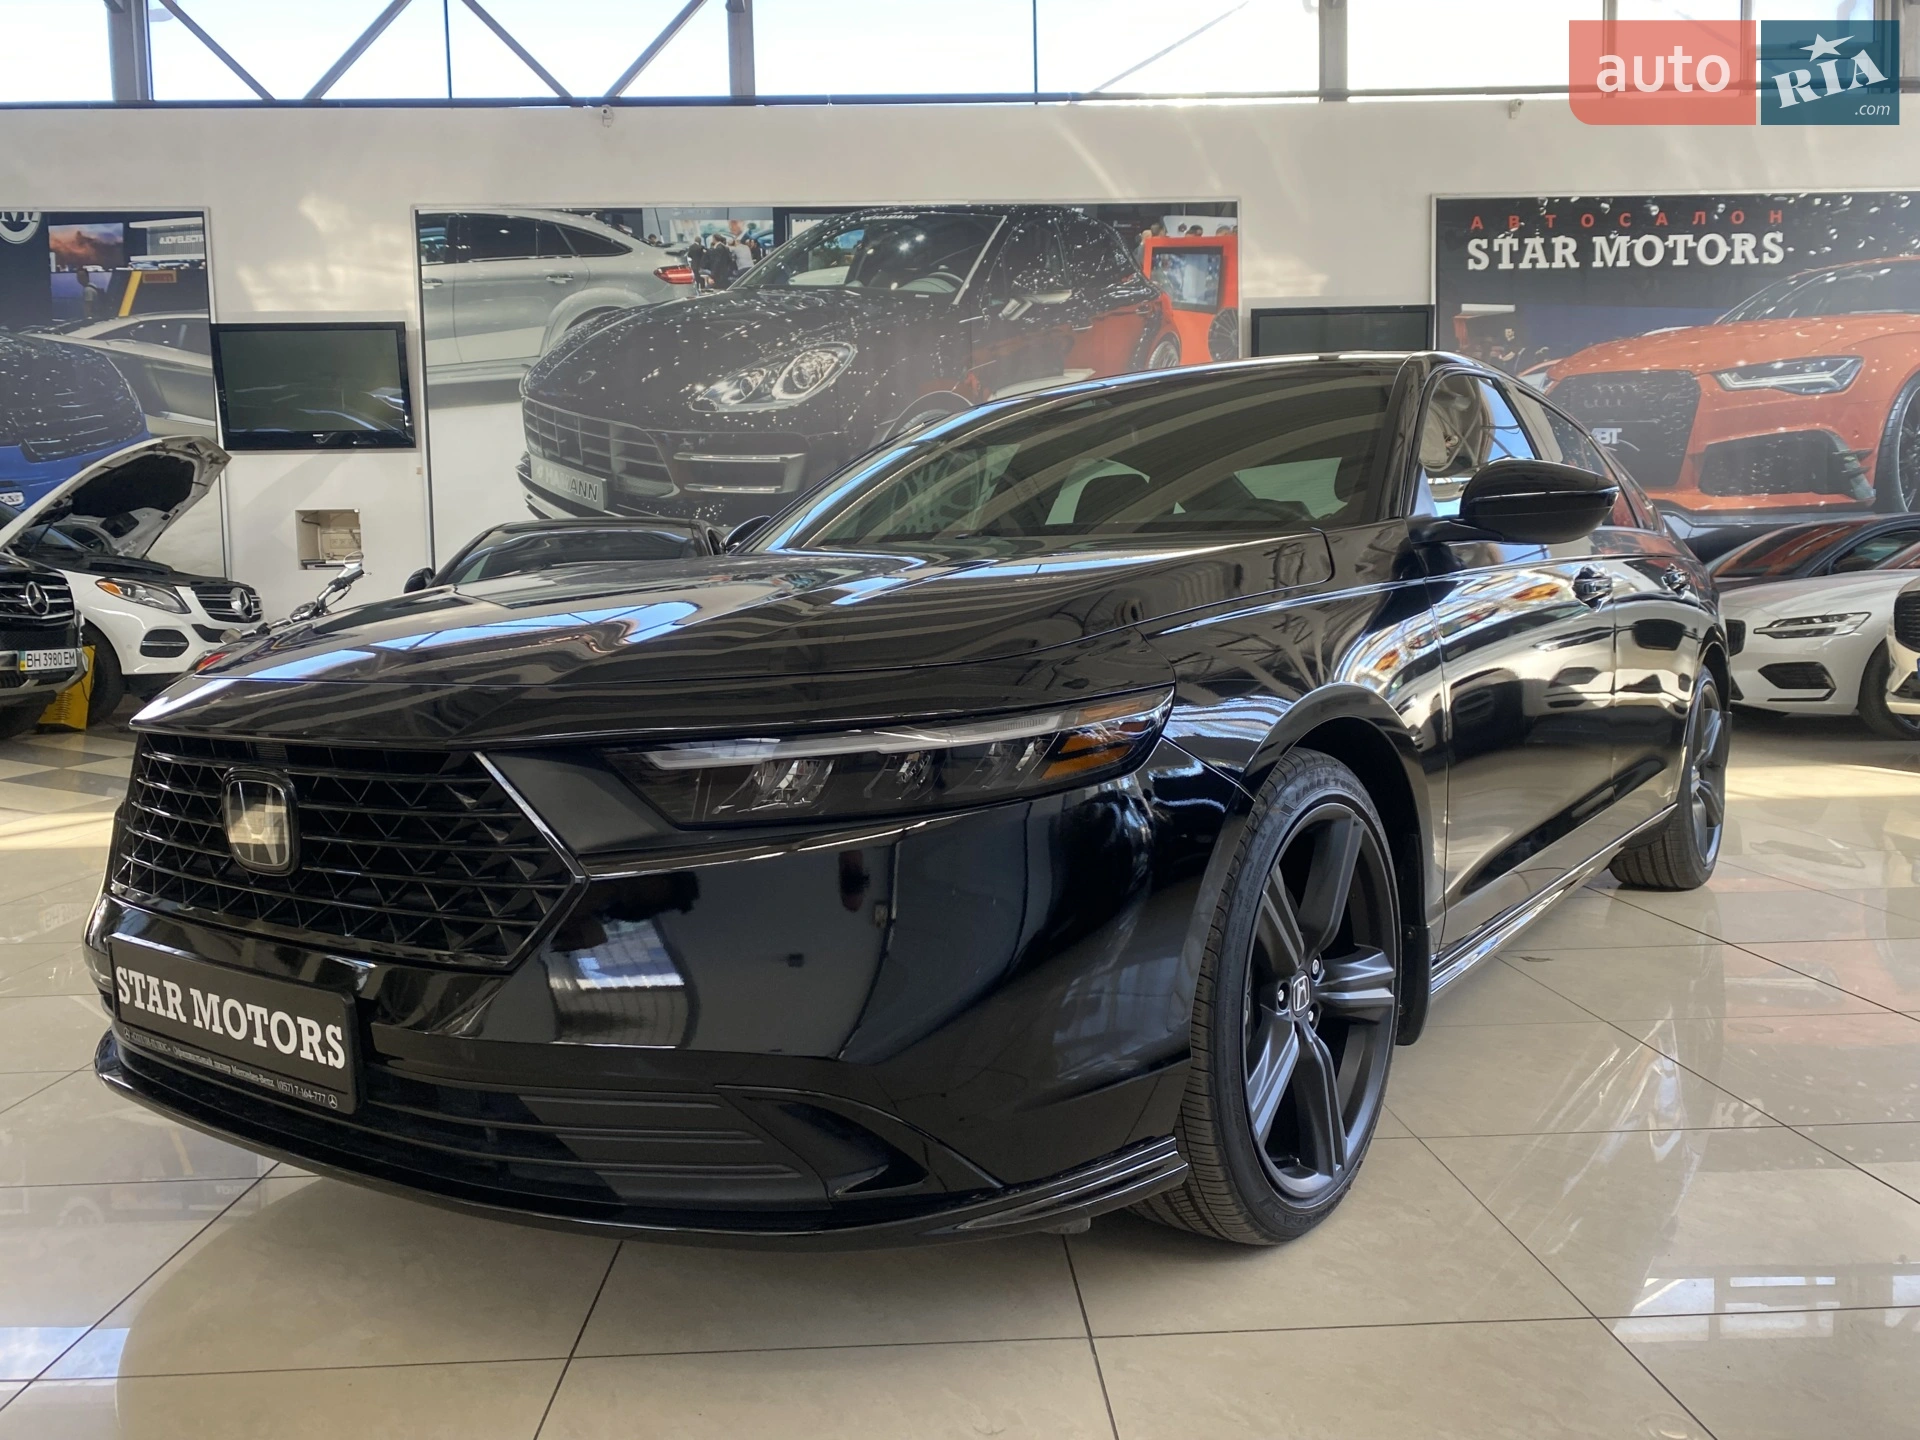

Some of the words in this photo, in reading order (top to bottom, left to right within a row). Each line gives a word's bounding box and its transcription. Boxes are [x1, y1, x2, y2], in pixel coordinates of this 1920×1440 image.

[1471, 210, 1784, 231] АВТОСАЛОН
[1467, 236, 1580, 271] STAR
[1592, 231, 1786, 268] MOTORS
[27, 653, 41, 668] BH
[43, 652, 62, 667] 3980
[64, 651, 76, 666] EM
[116, 966, 187, 1023] STAR
[190, 987, 345, 1069] MOTORS
